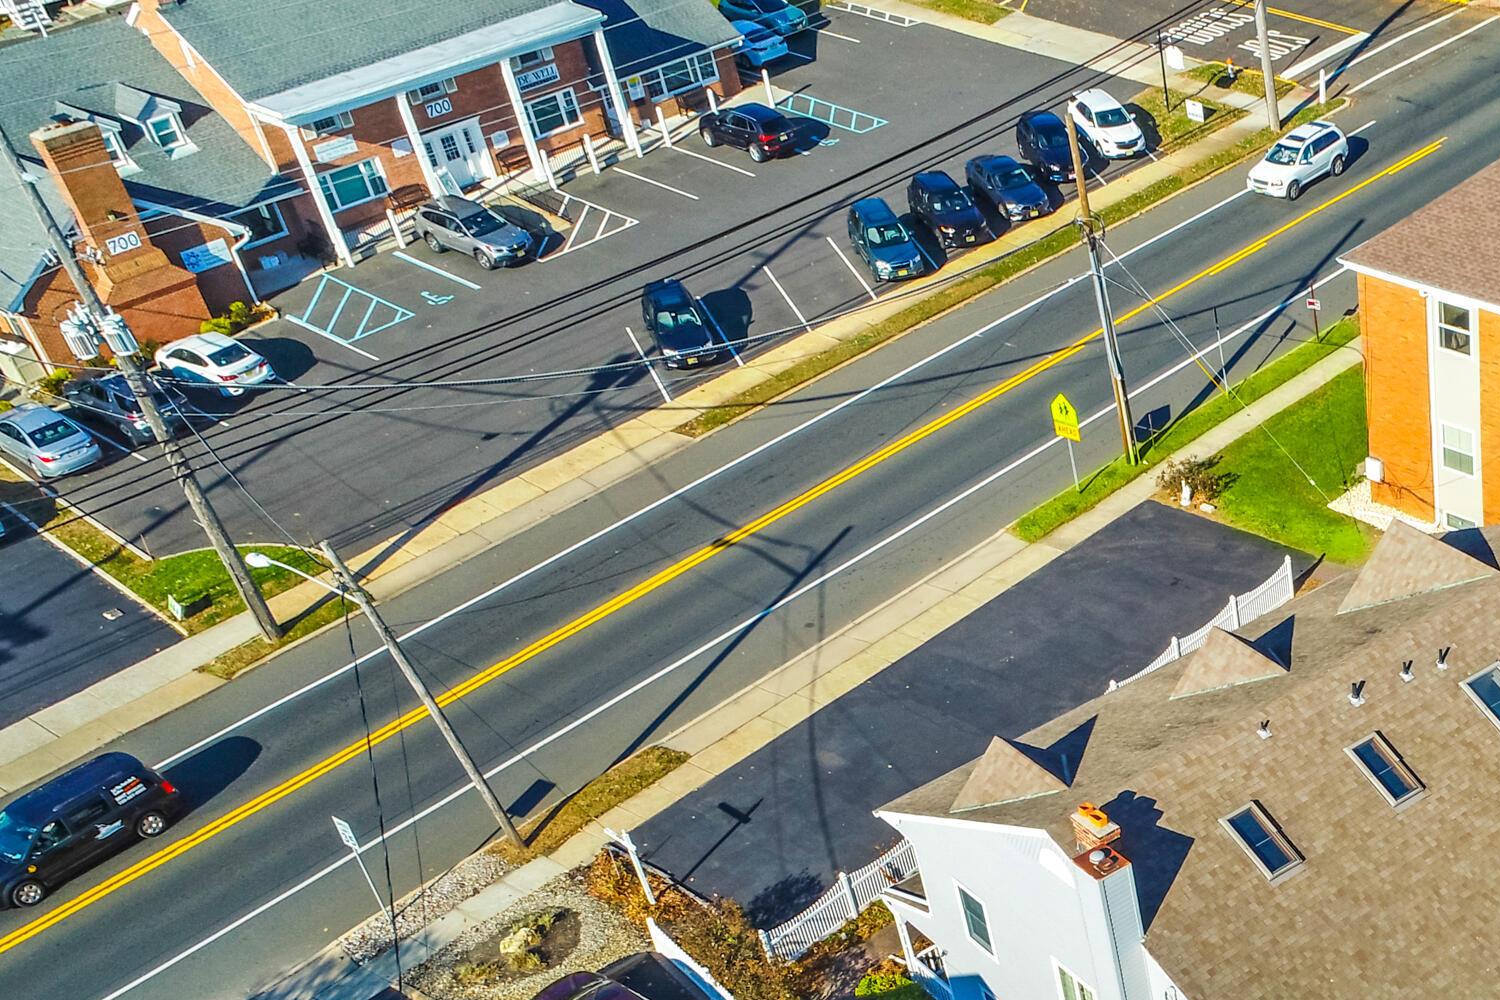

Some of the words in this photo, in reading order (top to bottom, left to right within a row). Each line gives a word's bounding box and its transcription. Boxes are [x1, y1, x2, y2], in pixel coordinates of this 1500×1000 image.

[1238, 29, 1311, 61] STOP
[426, 99, 451, 117] 700
[108, 233, 139, 253] 700
